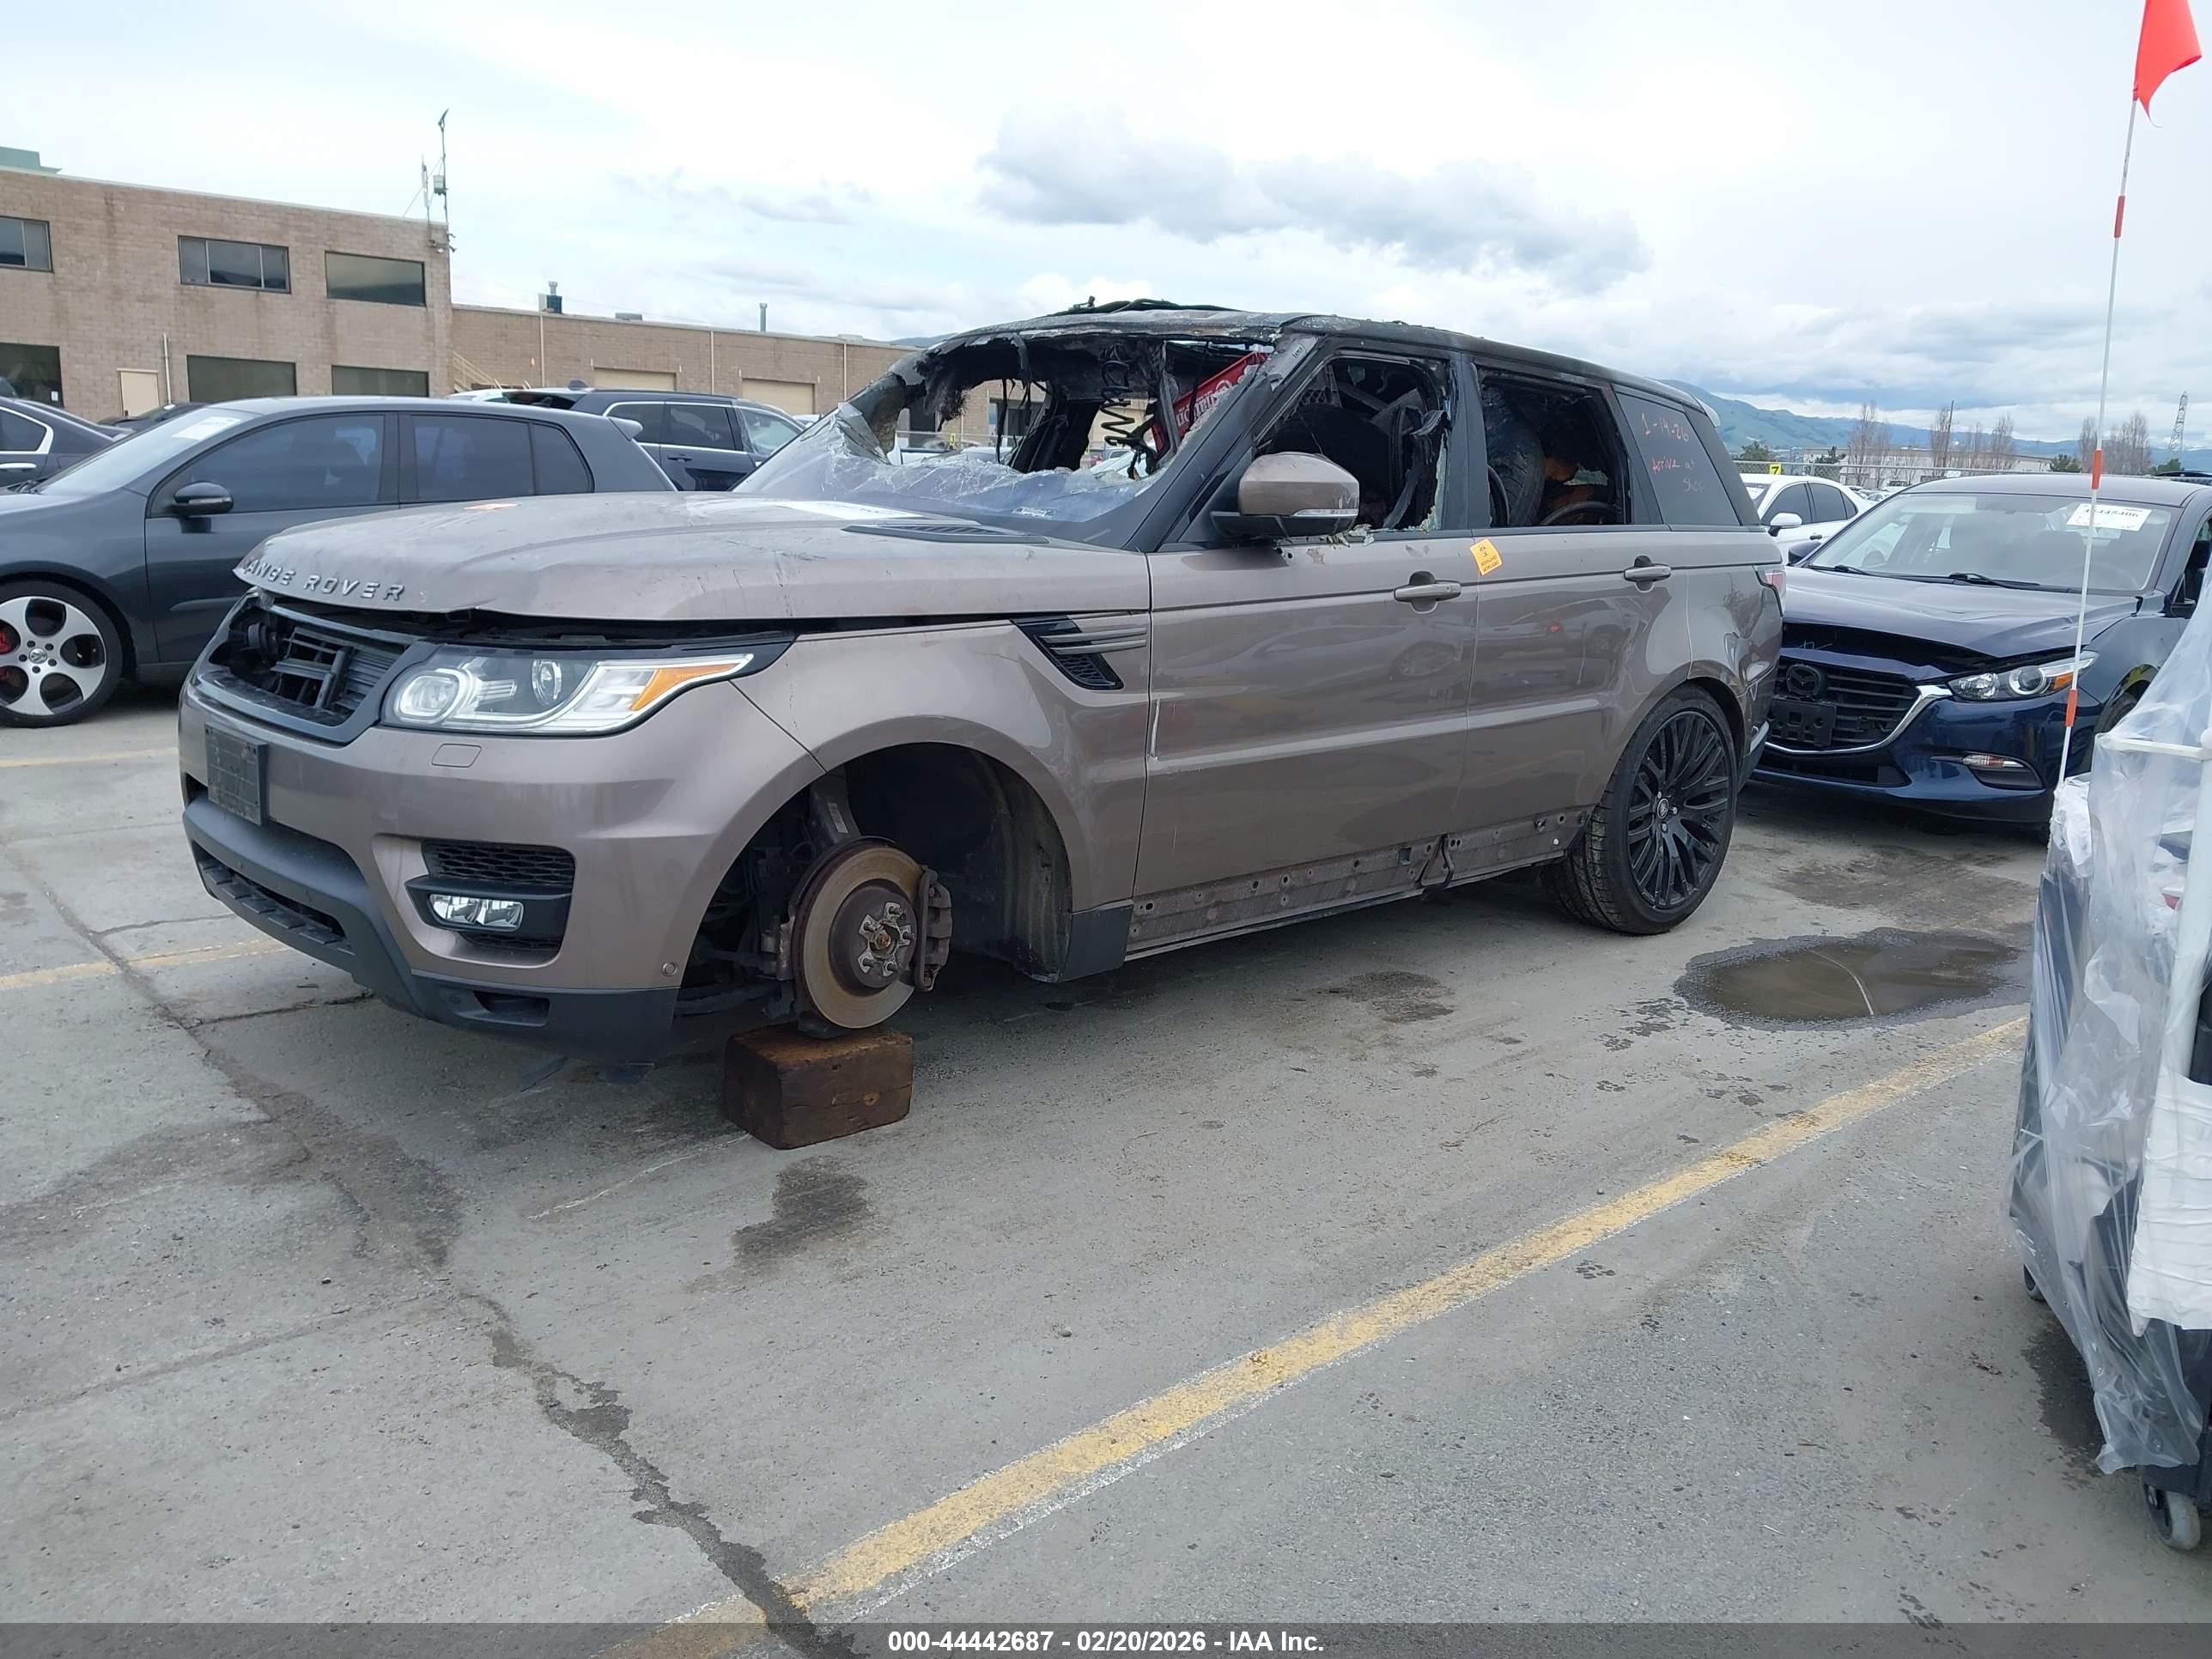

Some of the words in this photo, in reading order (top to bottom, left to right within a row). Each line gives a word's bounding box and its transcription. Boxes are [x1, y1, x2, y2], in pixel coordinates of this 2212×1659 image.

[1771, 466, 1779, 475] 7
[243, 559, 296, 586] ANGE
[303, 574, 404, 601] ROVER
